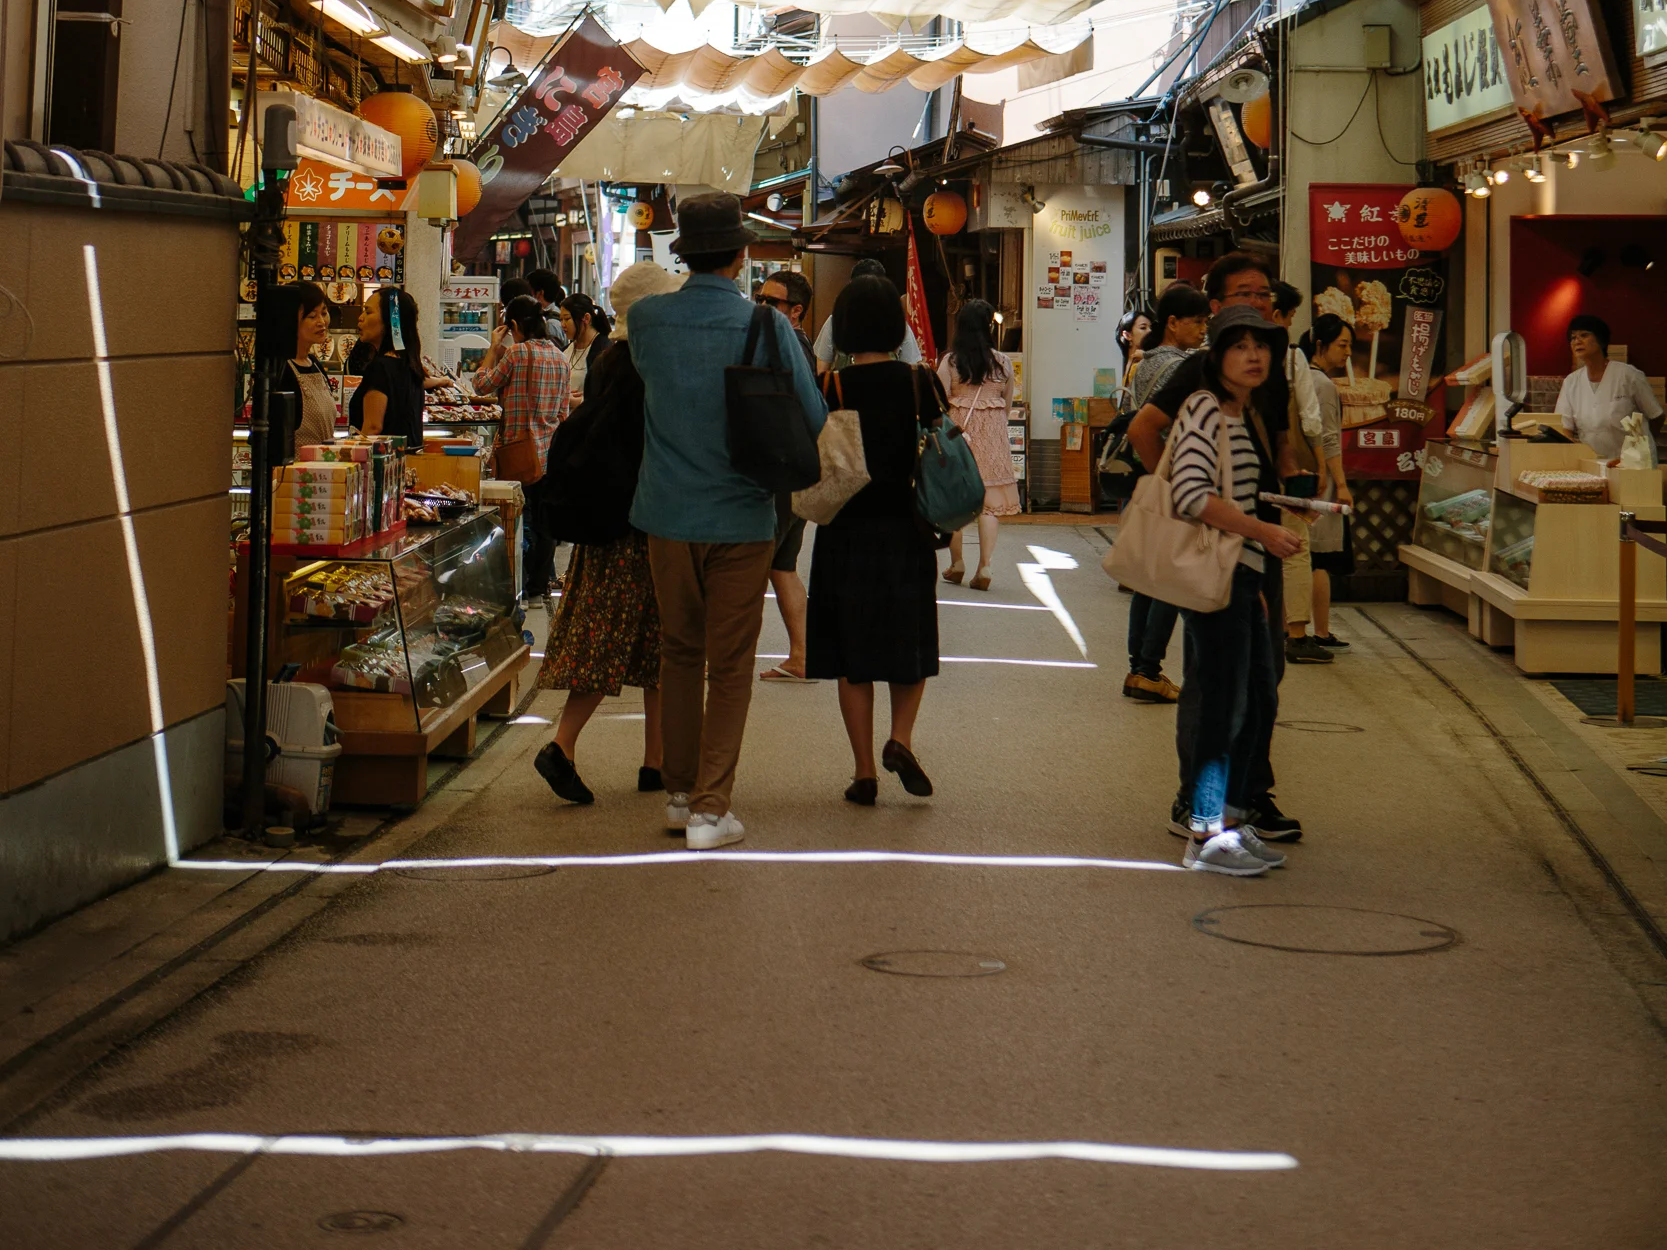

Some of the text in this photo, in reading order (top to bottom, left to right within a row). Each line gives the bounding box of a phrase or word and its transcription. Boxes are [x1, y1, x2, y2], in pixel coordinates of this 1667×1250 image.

[1049, 220, 1111, 242] fruit juice
[1328, 235, 1390, 250] ここだけの
[1344, 249, 1420, 265] 美味しいもの
[453, 287, 490, 298] チチヤス
[1407, 323, 1431, 396] 揚げもみじ
[1395, 407, 1425, 422] 180円
[1363, 431, 1395, 446] 宮島
